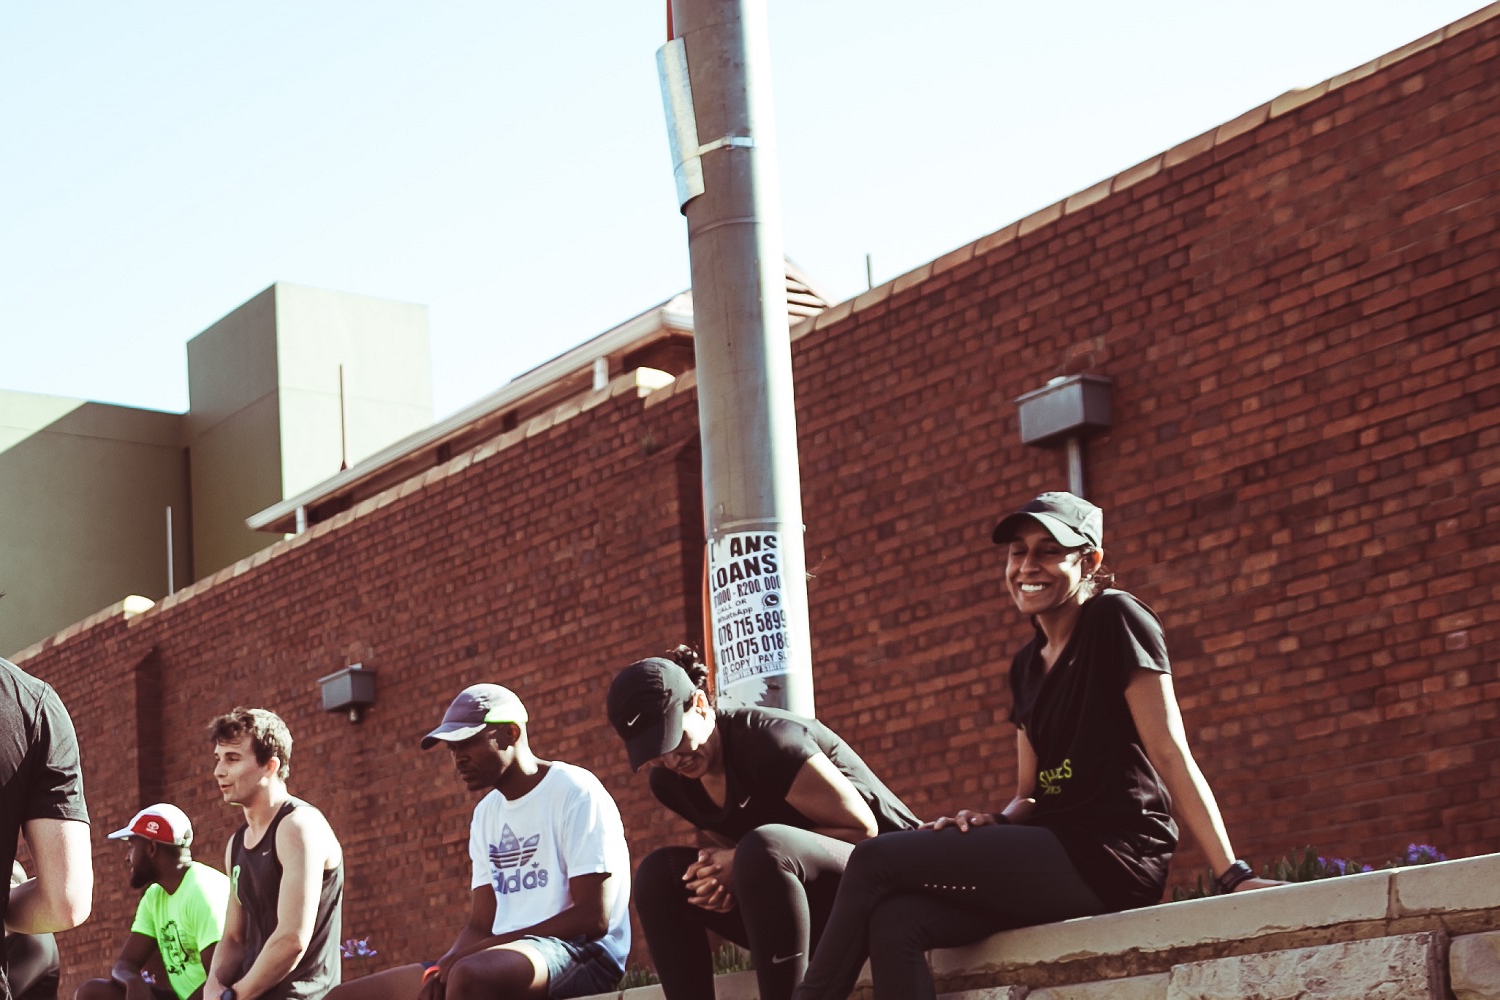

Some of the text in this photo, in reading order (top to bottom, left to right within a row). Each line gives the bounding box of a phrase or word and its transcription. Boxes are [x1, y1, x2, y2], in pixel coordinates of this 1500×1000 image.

[712, 553, 778, 592] LOANS
[735, 598, 747, 607] OR
[718, 623, 733, 646] 078
[734, 615, 754, 639] 715
[720, 645, 735, 665] 011
[737, 637, 759, 659] 075
[730, 656, 752, 673] COPY
[758, 651, 777, 665] PAY
[493, 869, 548, 895] didas
